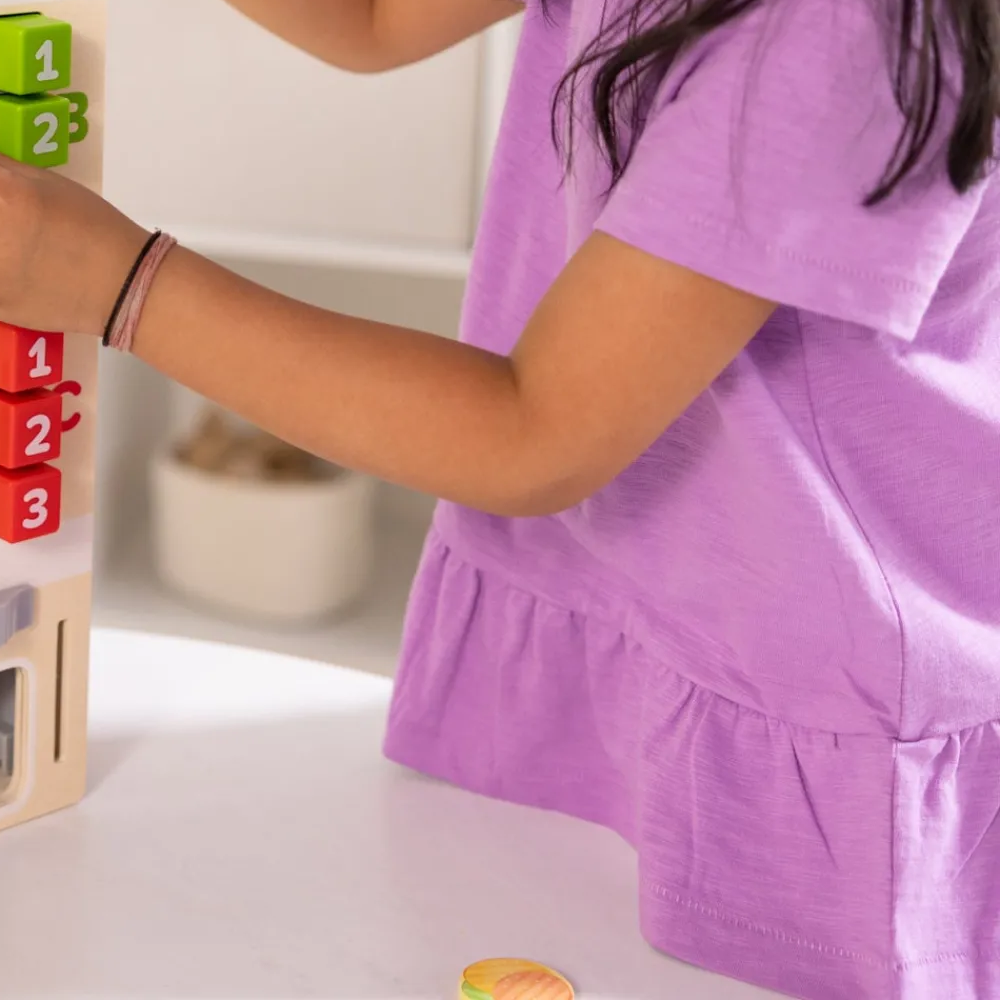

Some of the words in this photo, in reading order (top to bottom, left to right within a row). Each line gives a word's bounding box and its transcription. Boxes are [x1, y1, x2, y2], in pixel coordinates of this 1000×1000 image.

[35, 39, 59, 81] 1
[33, 112, 58, 155] 2
[28, 336, 52, 378] 1
[25, 414, 51, 456] 2
[22, 488, 48, 529] 3
